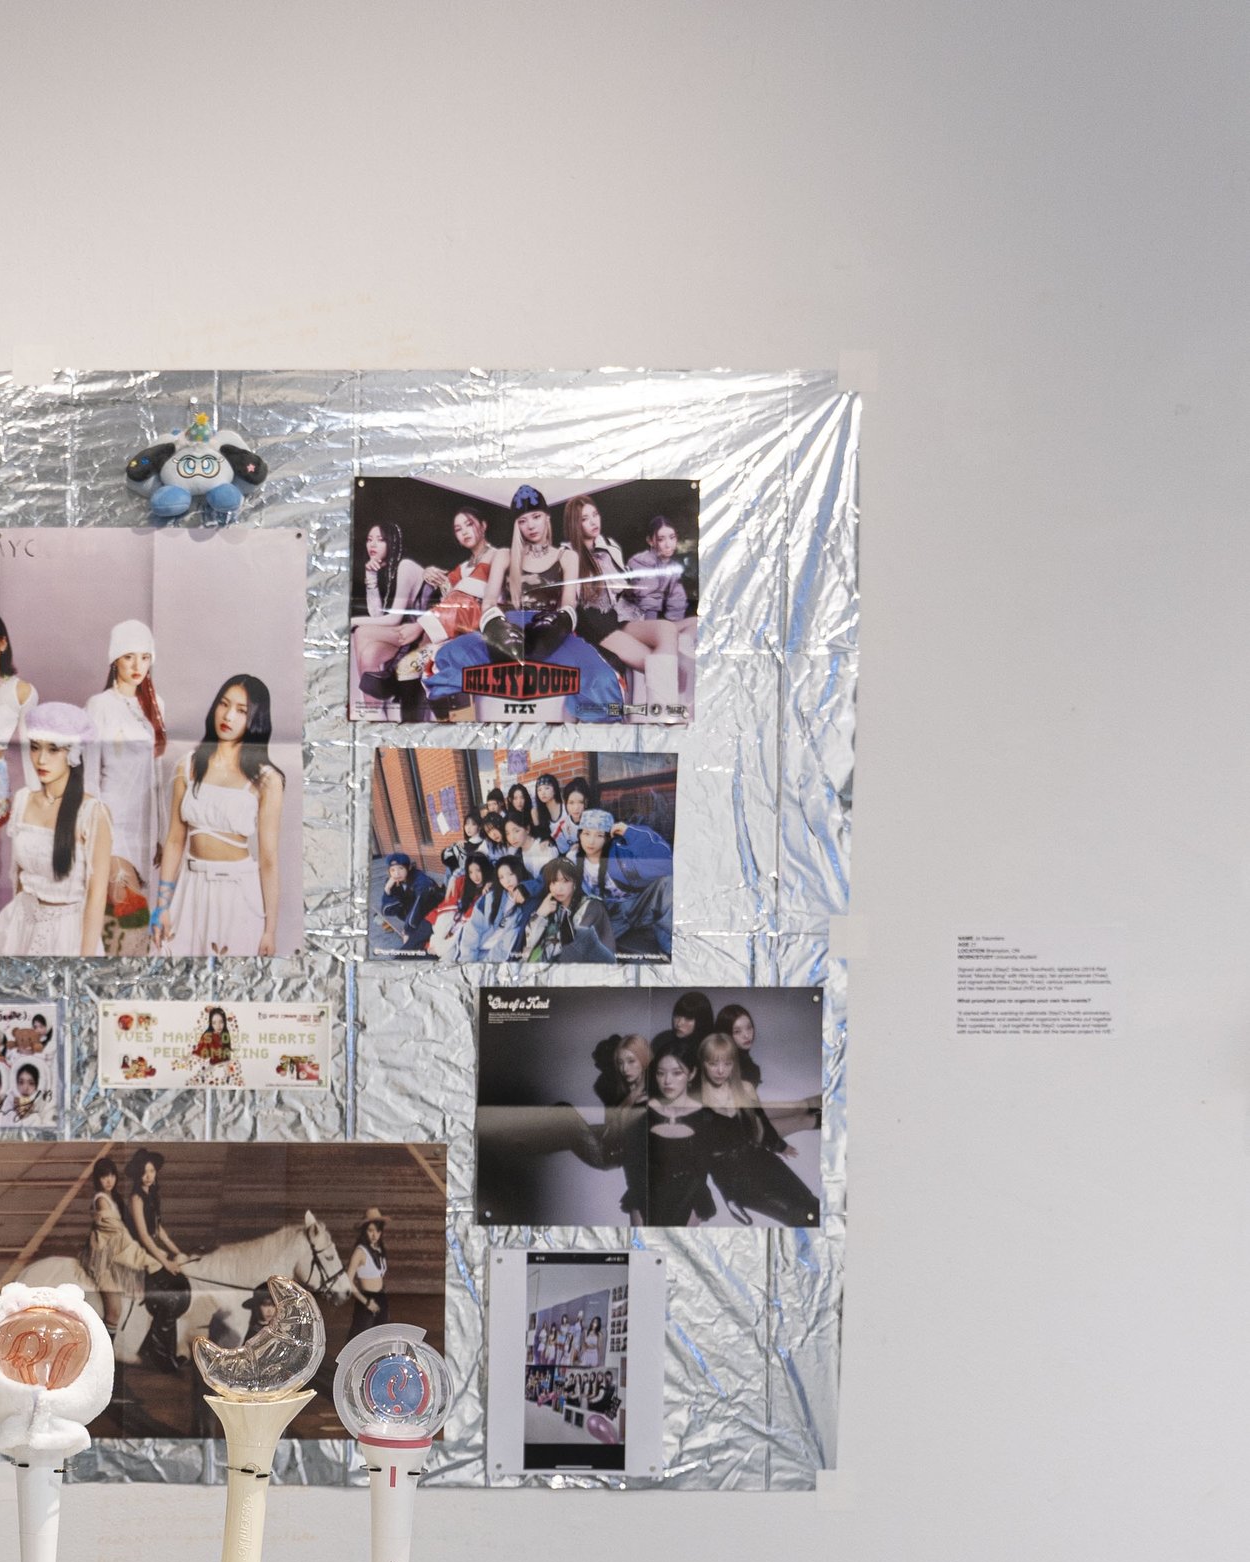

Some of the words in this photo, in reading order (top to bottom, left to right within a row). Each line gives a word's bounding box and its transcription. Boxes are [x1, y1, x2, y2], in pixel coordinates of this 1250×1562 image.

[465, 667, 490, 693] KILL
[491, 664, 524, 697] MY
[523, 663, 578, 697] DOUBT
[503, 703, 537, 715] ITZY
[258, 1032, 317, 1044] HEARTS
